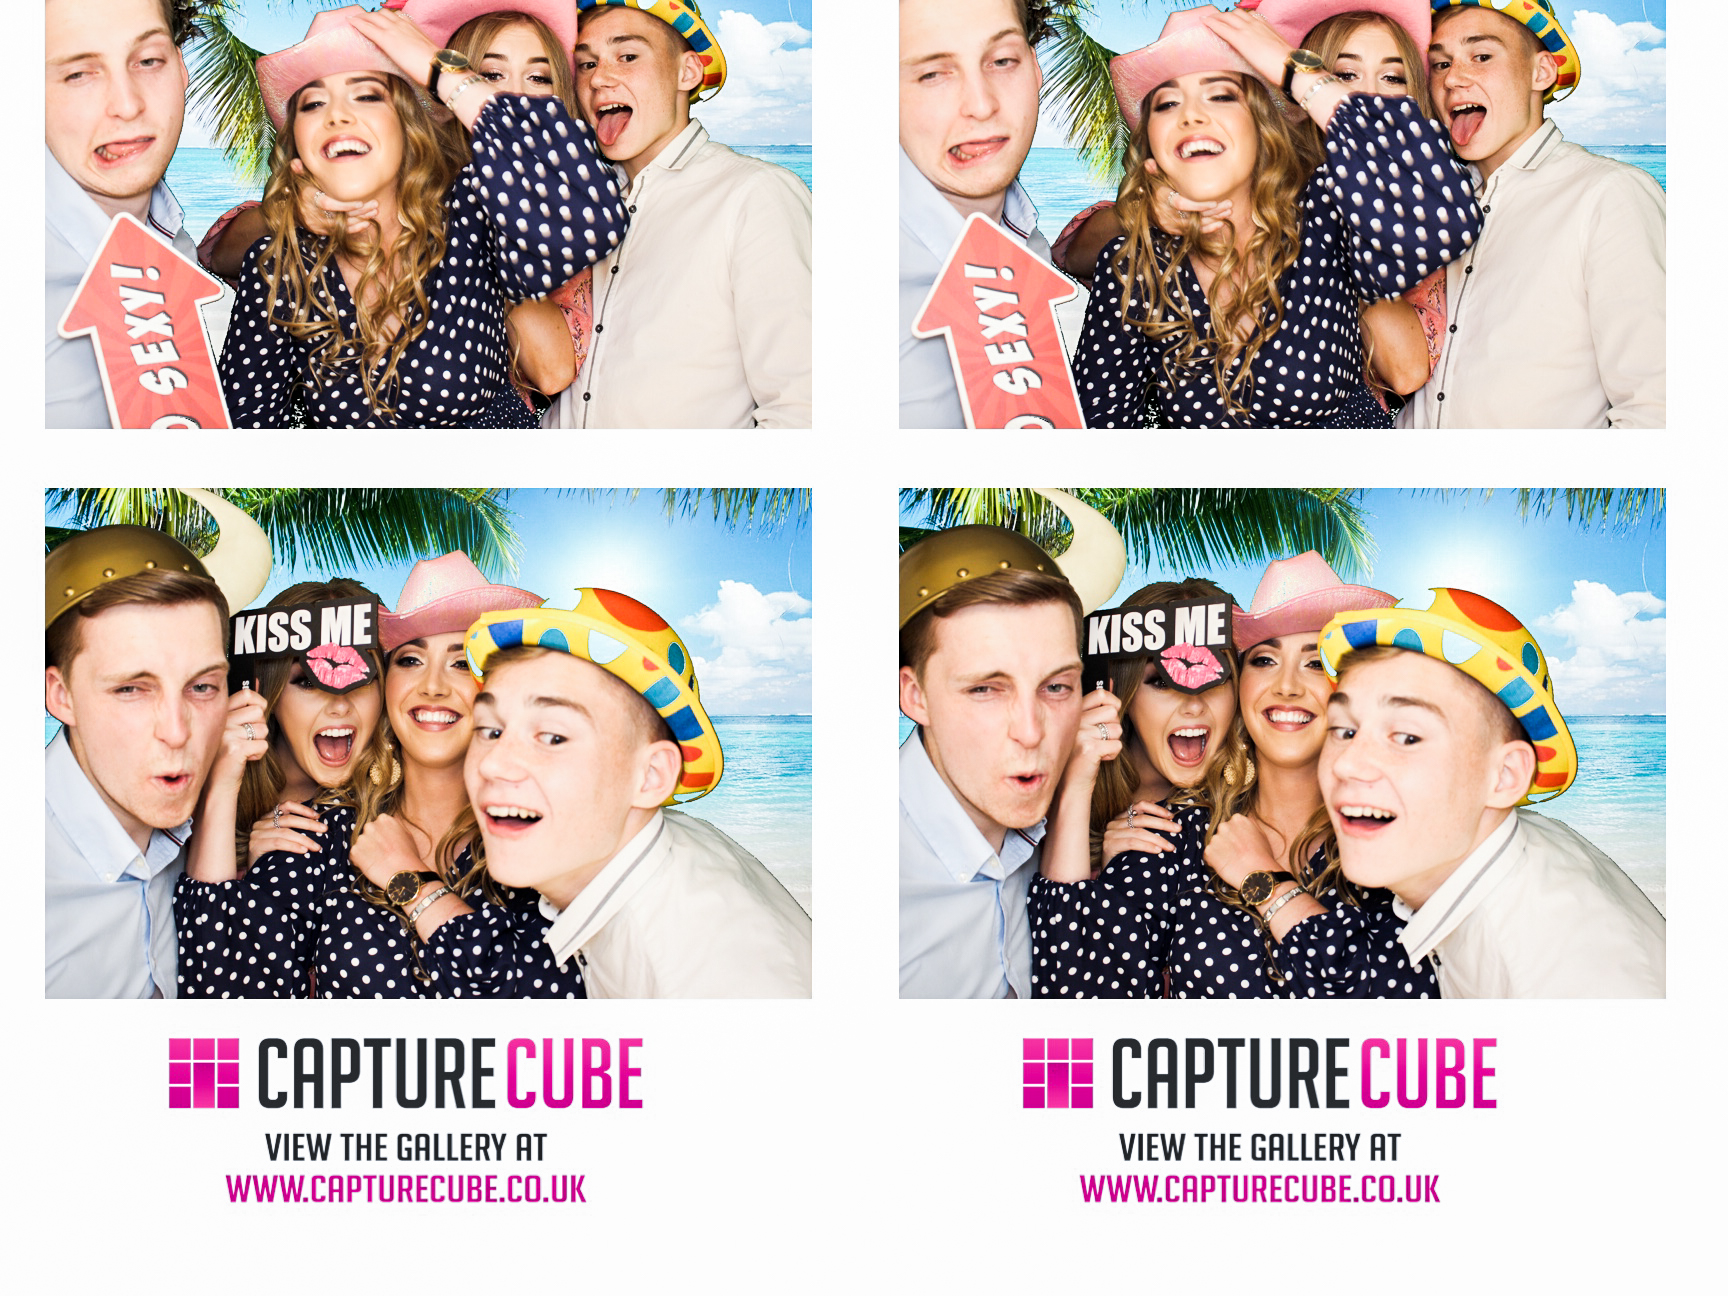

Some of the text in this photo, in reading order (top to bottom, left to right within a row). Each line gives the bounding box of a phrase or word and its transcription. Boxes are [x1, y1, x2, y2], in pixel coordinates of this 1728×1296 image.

[109, 262, 188, 396] SEXY!
[963, 262, 1042, 396] SEXY!
[234, 602, 372, 656] KISS ME
[1088, 602, 1226, 656] KISS ME
